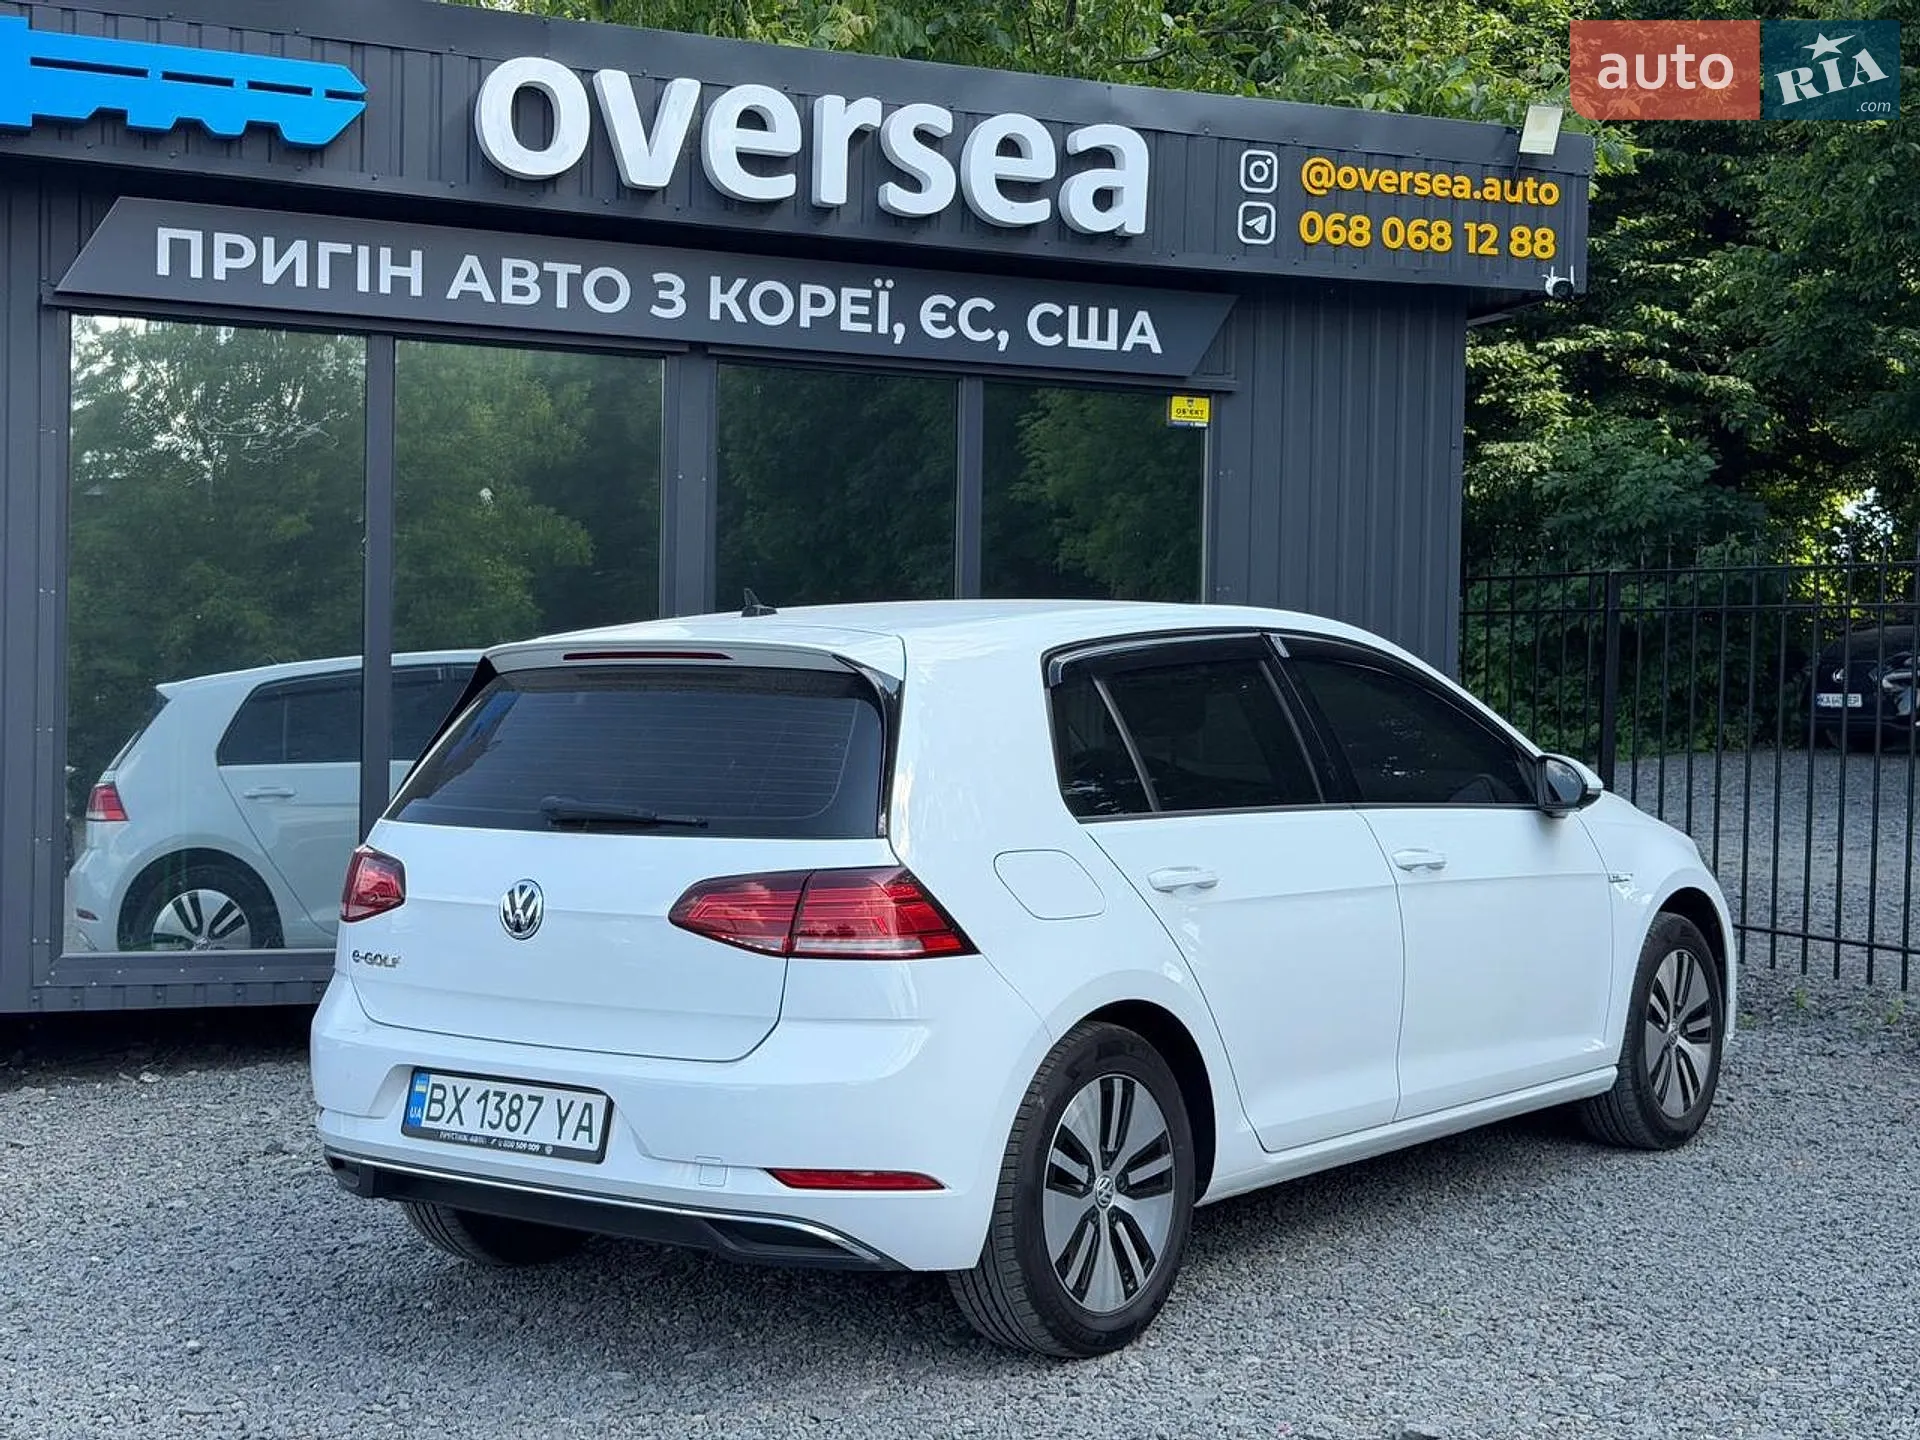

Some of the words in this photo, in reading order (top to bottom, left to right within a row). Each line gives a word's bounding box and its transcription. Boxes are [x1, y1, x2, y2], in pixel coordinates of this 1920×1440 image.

[474, 56, 1150, 237] oversea
[1301, 156, 1560, 206] @oversea.auto
[1299, 209, 1371, 249] 068
[1381, 214, 1452, 253] 068
[1464, 220, 1499, 257] 12
[1509, 224, 1557, 261] 88
[156, 226, 423, 298] ПРИГІН
[446, 254, 631, 315] АВТО
[650, 272, 687, 320] З
[709, 275, 906, 345] КОРЕЇ,
[920, 295, 1009, 351] ЄС,
[1026, 302, 1163, 355] США
[409, 1105, 422, 1119] UA
[425, 1082, 471, 1126] BX
[475, 1088, 544, 1135] 1387
[556, 1098, 595, 1144] YA
